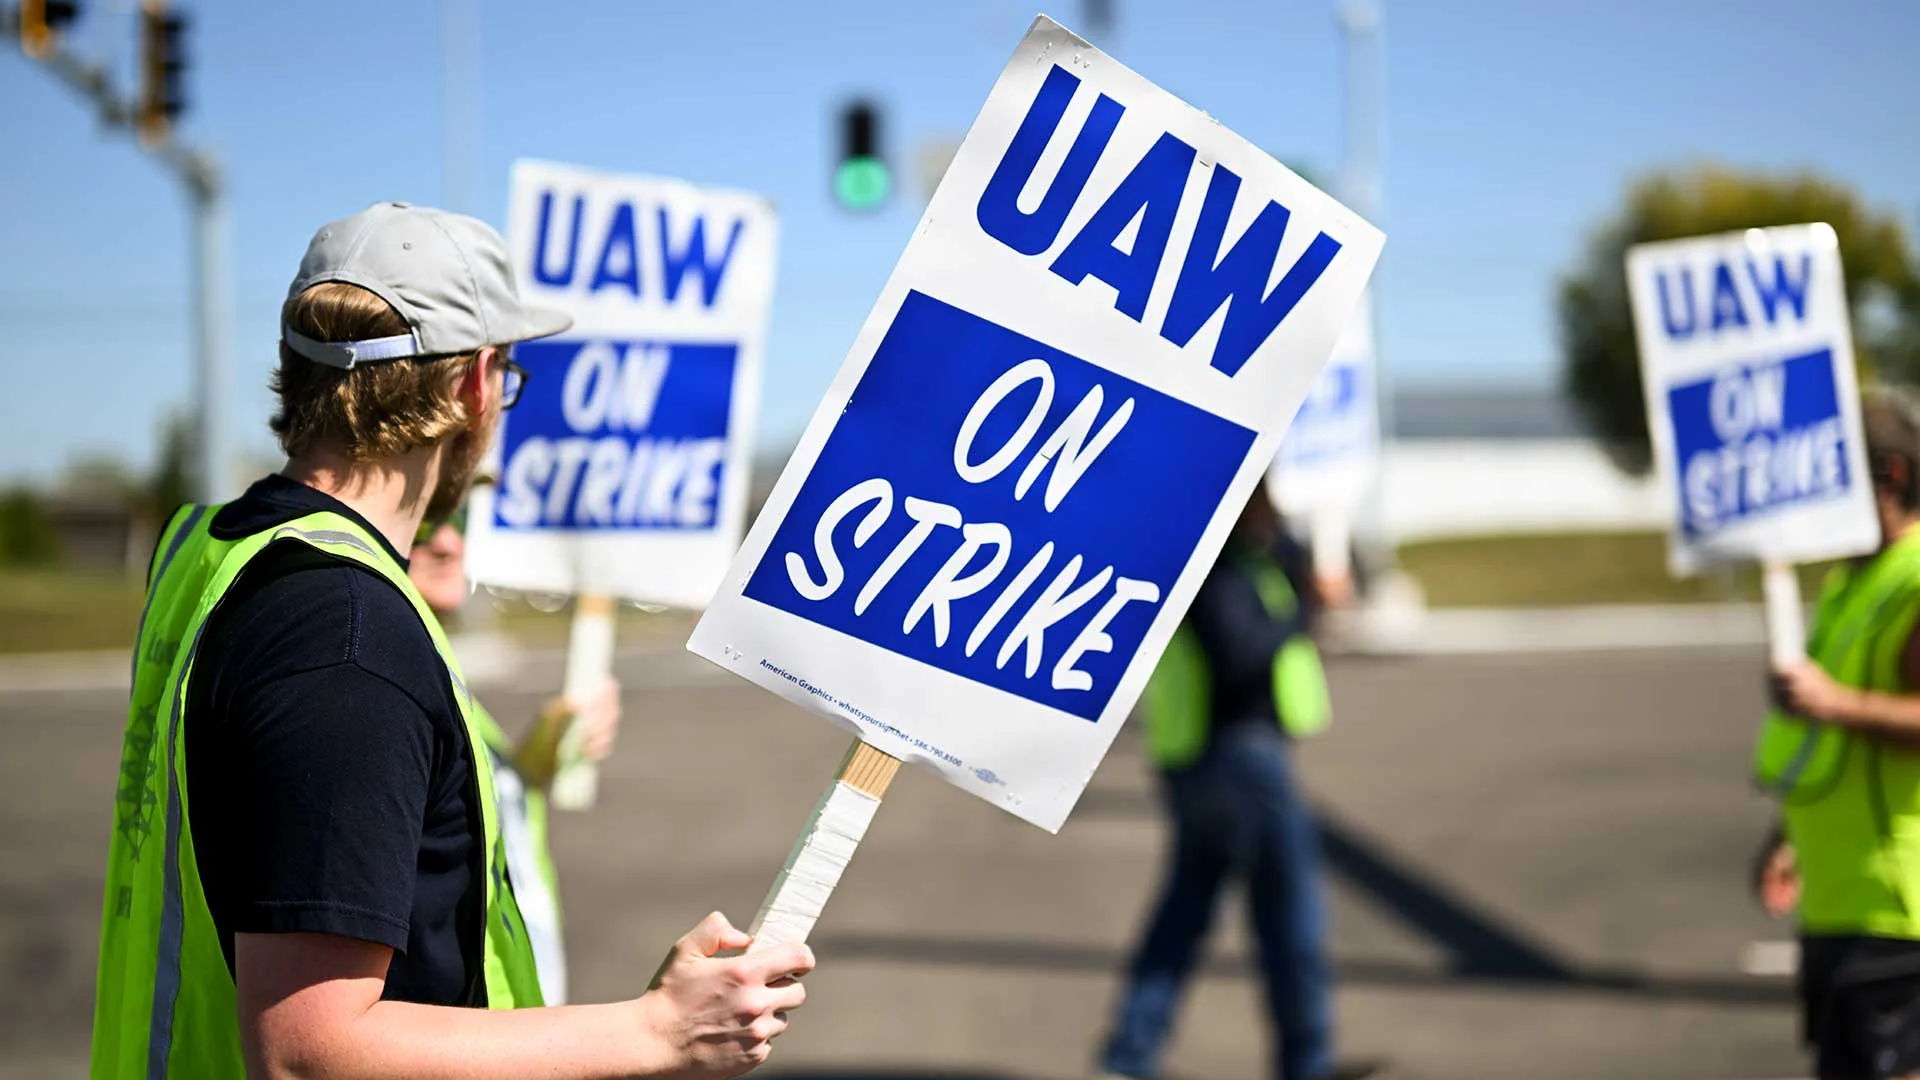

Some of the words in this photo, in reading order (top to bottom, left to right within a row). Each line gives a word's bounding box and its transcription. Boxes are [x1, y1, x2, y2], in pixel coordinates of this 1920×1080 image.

[533, 190, 744, 306] UAW
[976, 63, 1343, 379] UAW
[1657, 255, 1811, 338] UAW
[561, 342, 671, 433] ON
[953, 358, 1135, 513] ON
[502, 437, 728, 528] STRIKE
[785, 478, 1160, 692] STRIKE
[760, 659, 798, 684] American
[798, 679, 833, 702] Graphics
[914, 739, 963, 768] 586.790.8500
